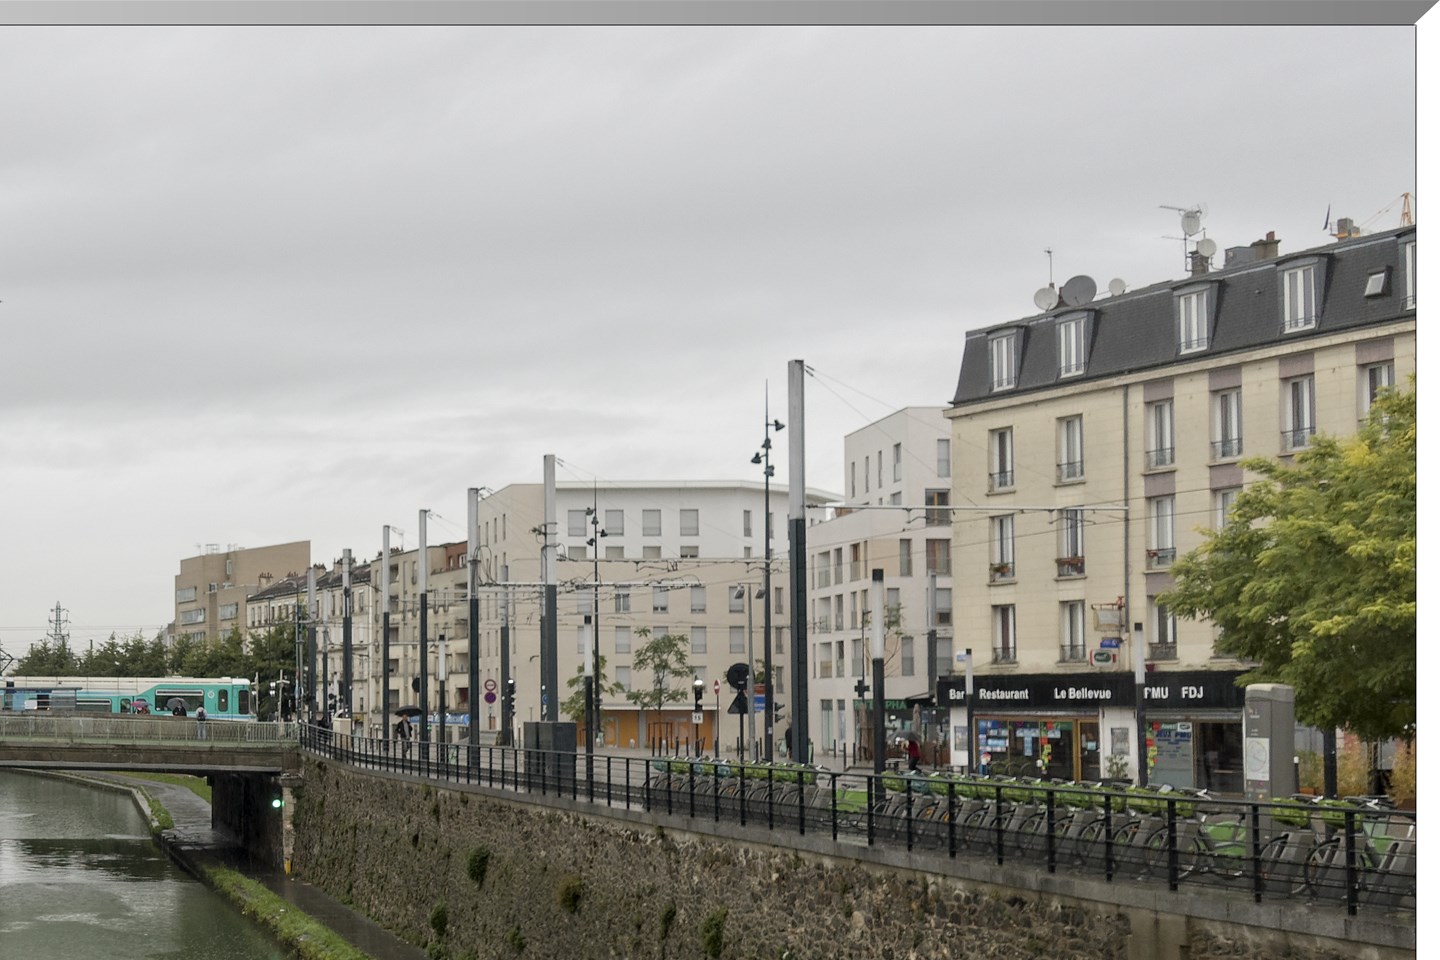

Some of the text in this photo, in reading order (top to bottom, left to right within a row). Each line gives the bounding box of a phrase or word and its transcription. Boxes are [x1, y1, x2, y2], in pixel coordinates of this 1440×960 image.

[949, 685, 1204, 700] Bar Restaurant Le Bellevue PMU FDJ
